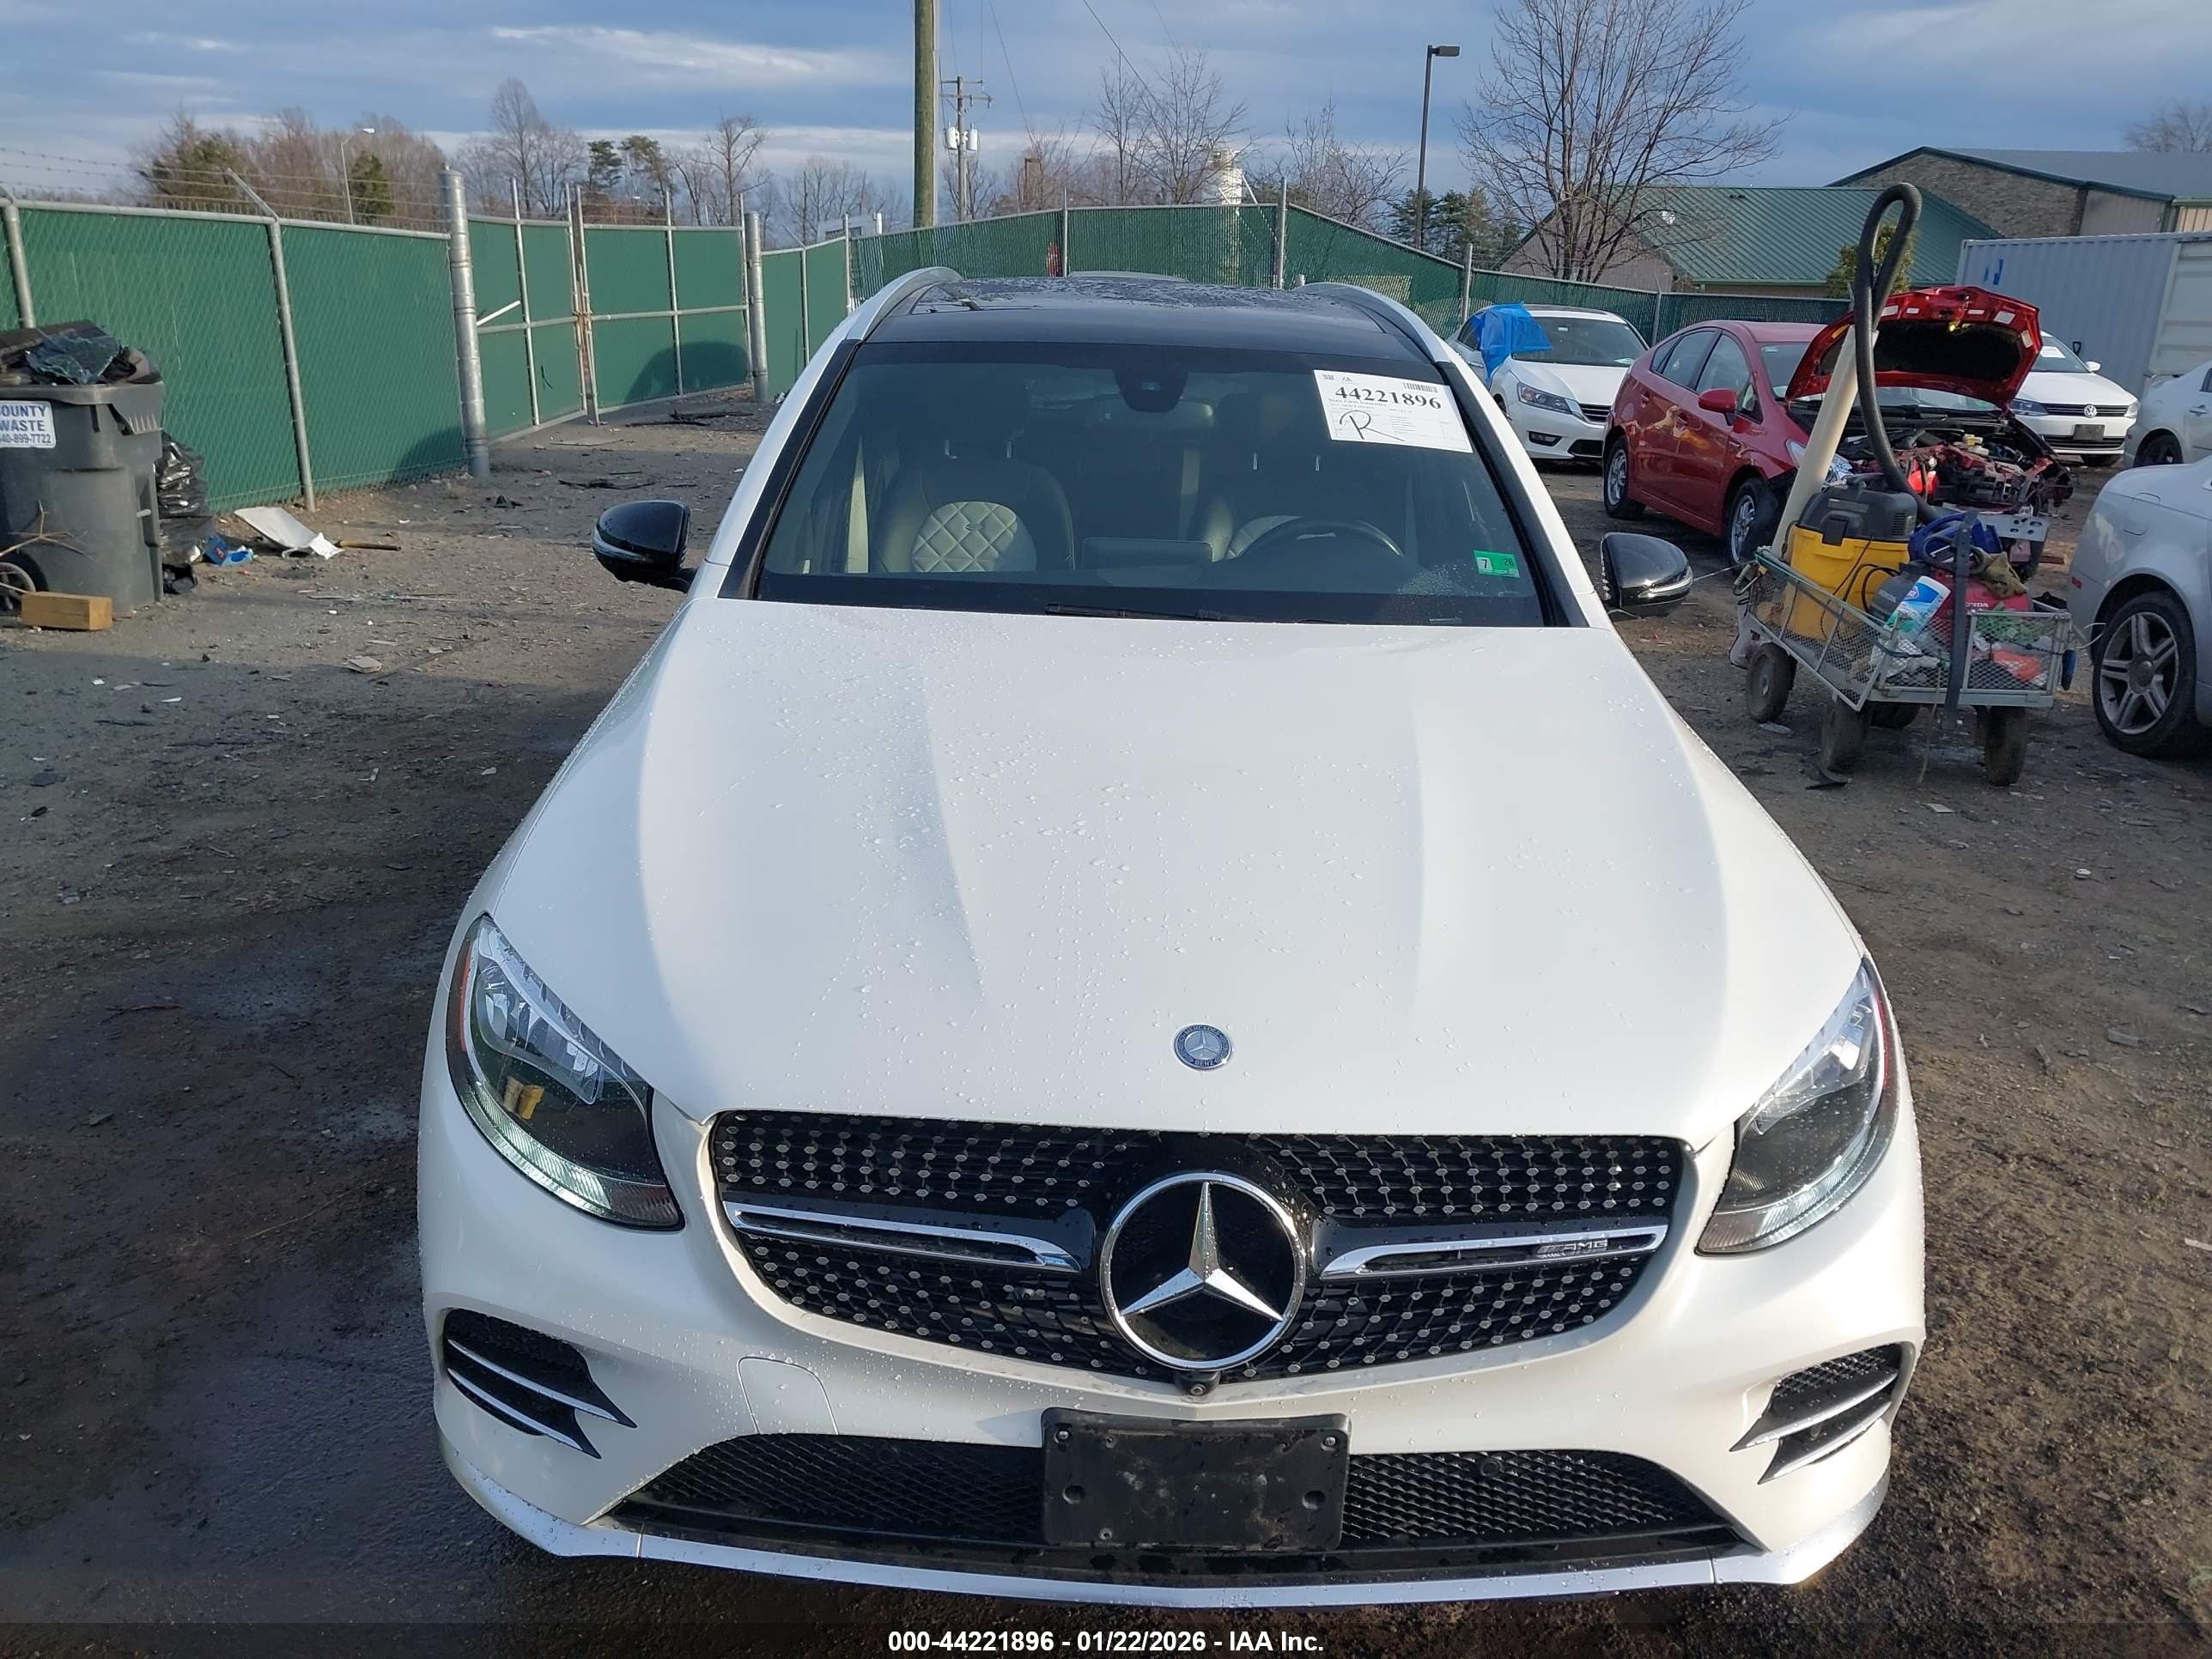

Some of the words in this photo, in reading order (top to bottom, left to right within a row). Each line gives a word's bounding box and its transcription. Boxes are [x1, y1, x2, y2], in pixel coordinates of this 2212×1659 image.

[1335, 386, 1442, 410] 44221896
[0, 404, 46, 417] OUNTY
[0, 419, 46, 432] WASTE
[1340, 410, 1406, 442] R
[1564, 1239, 1608, 1251] AMG
